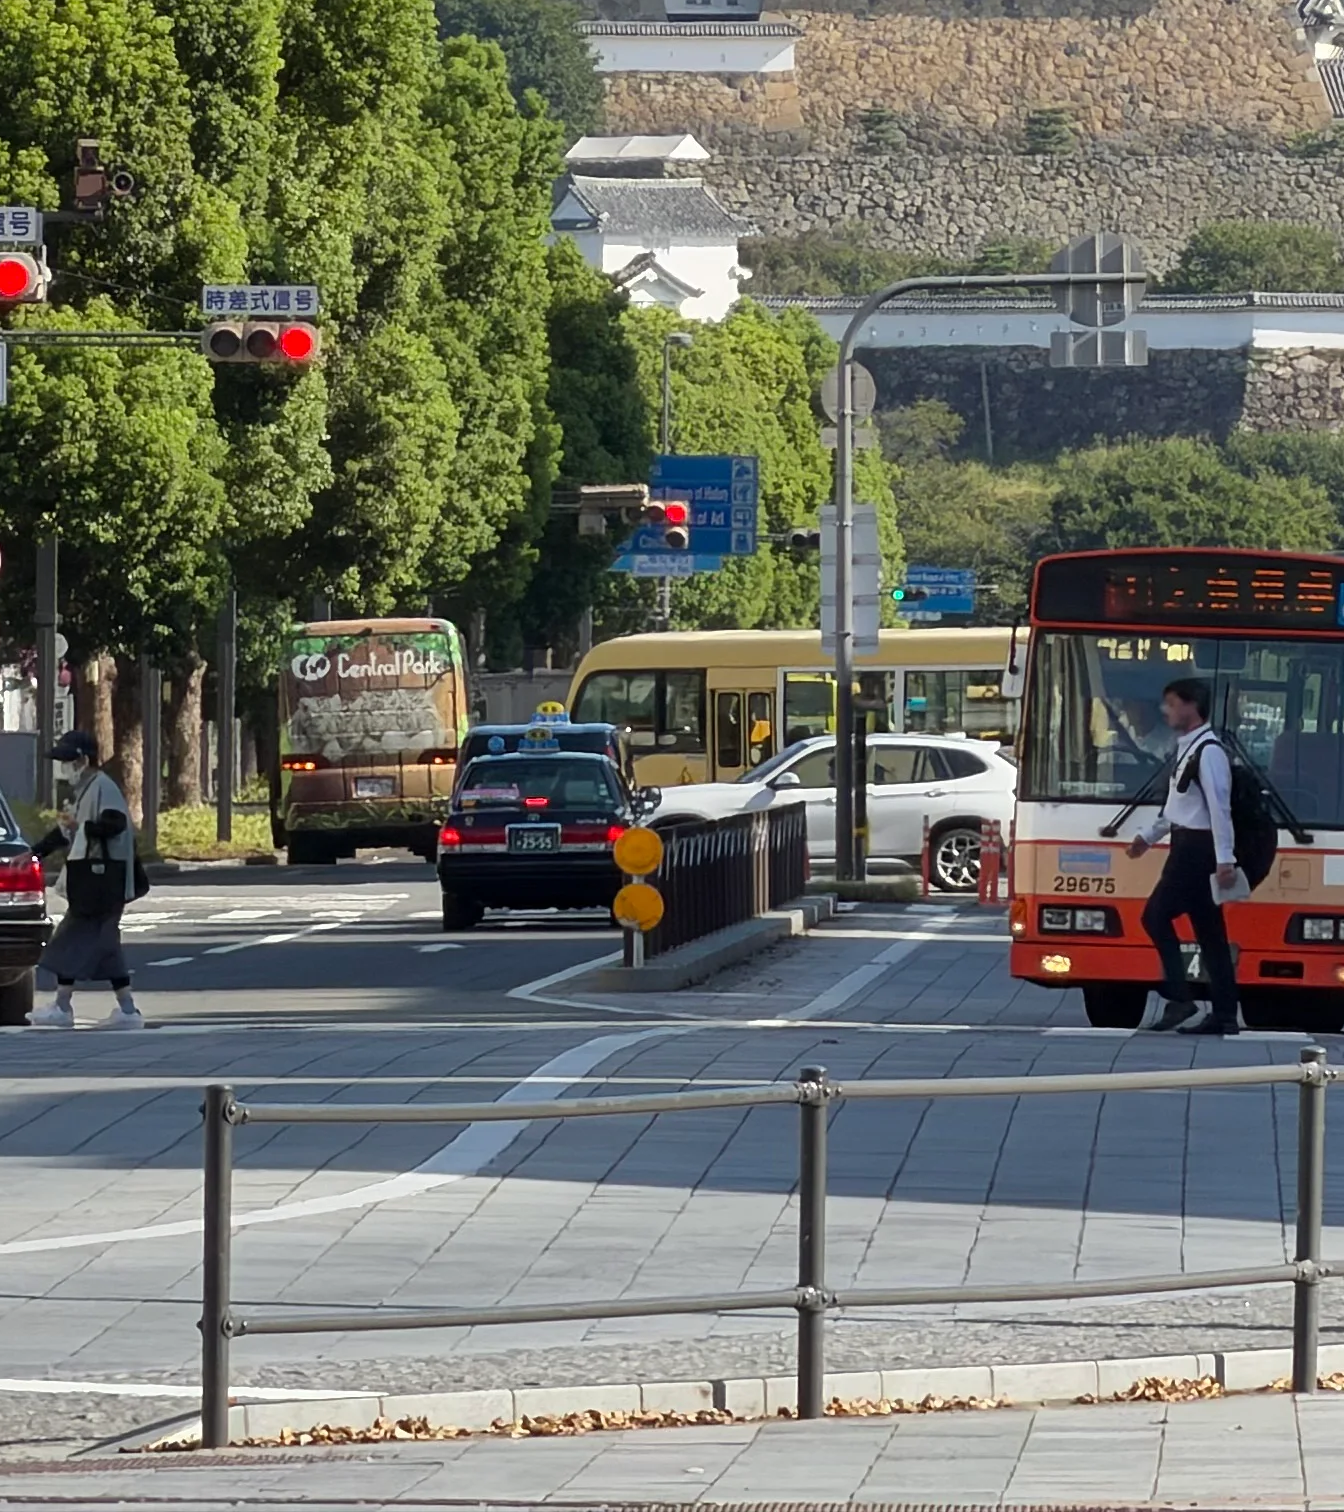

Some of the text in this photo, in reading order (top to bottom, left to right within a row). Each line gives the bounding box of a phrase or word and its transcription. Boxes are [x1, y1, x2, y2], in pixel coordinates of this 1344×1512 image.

[207, 290, 313, 311] 時差式信号
[1053, 875, 1116, 894] 29675
